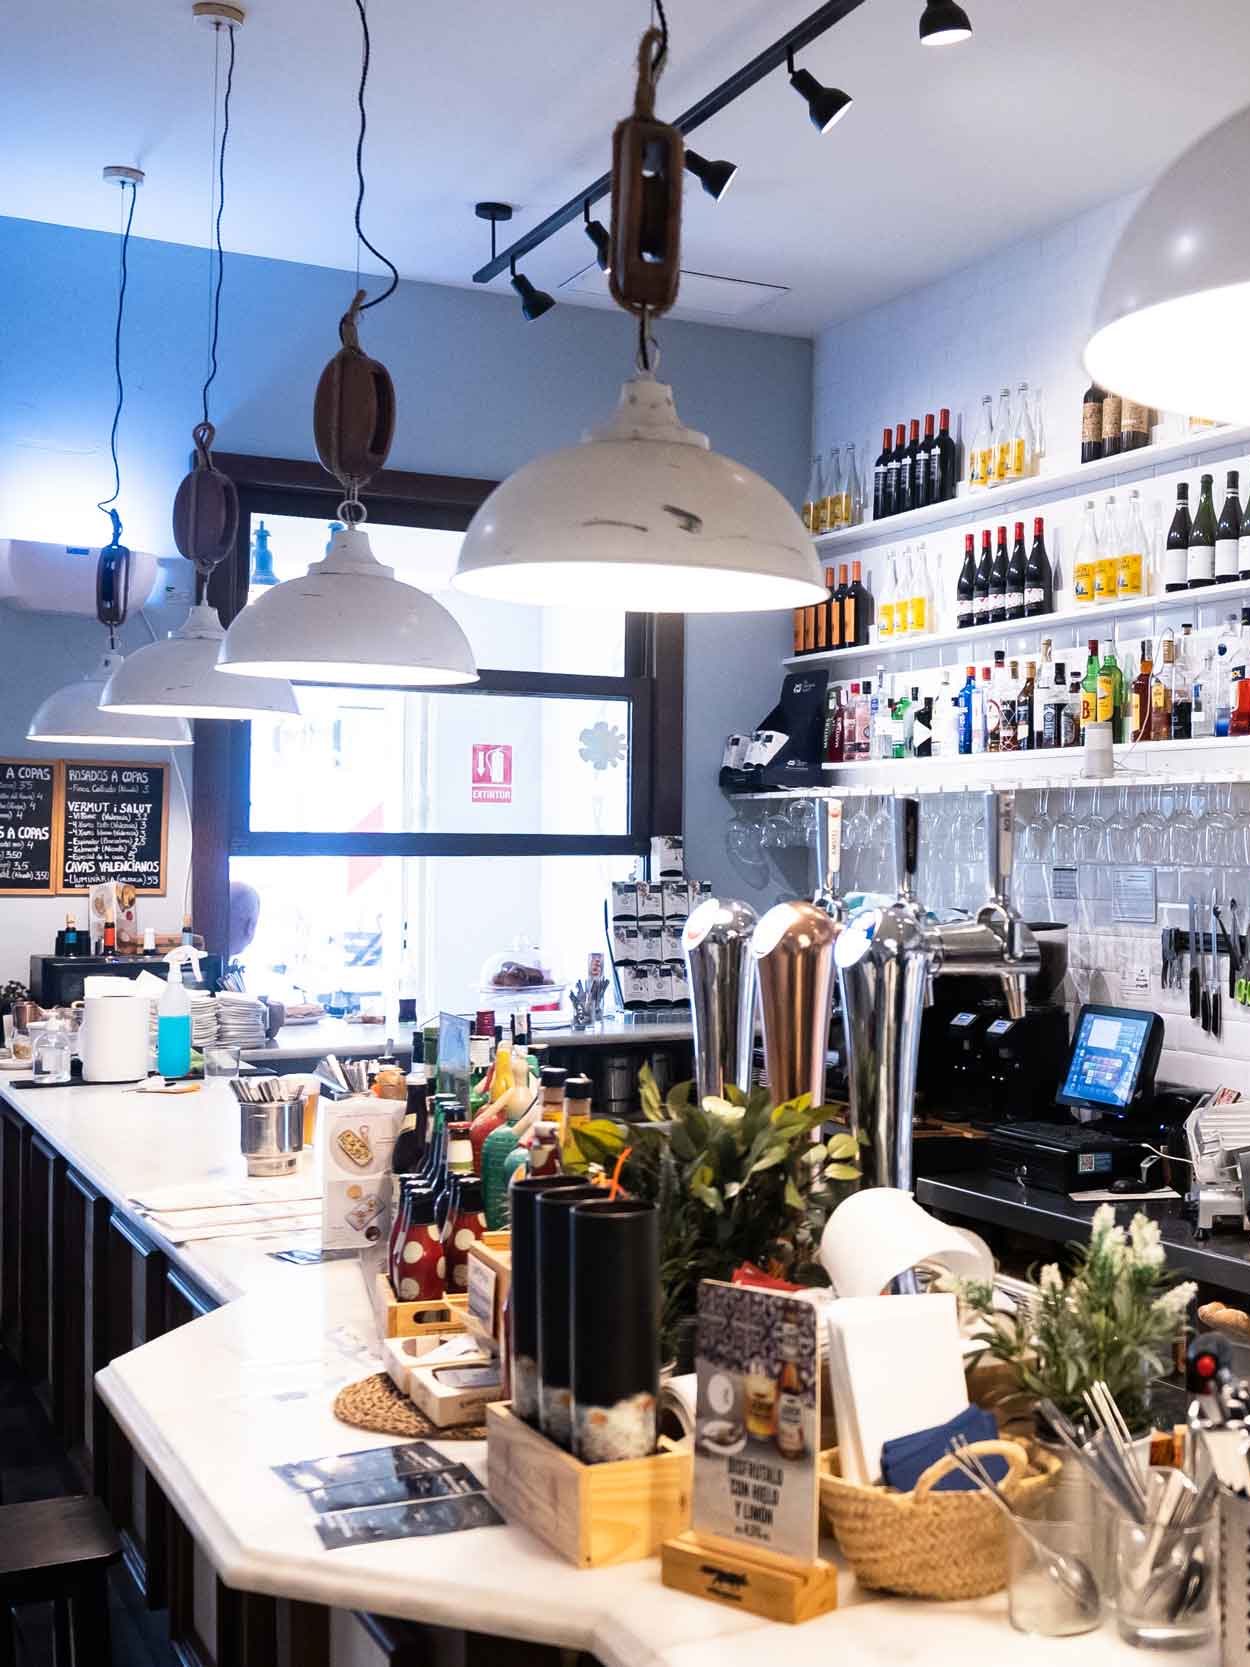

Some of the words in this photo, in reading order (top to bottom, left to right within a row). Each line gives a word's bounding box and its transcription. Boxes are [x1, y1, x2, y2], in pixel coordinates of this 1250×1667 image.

[6, 767, 15, 779] A
[18, 767, 51, 780] COPAS
[111, 771, 119, 782] A
[122, 771, 149, 784] COPAS
[473, 790, 512, 800] EXTINTOR
[67, 801, 110, 812] VERMUT
[120, 803, 152, 813] SALUT
[7, 827, 15, 839] A
[17, 827, 50, 840] COPAS
[65, 861, 96, 873] CAVAS
[99, 860, 160, 873] VALENCIANOS
